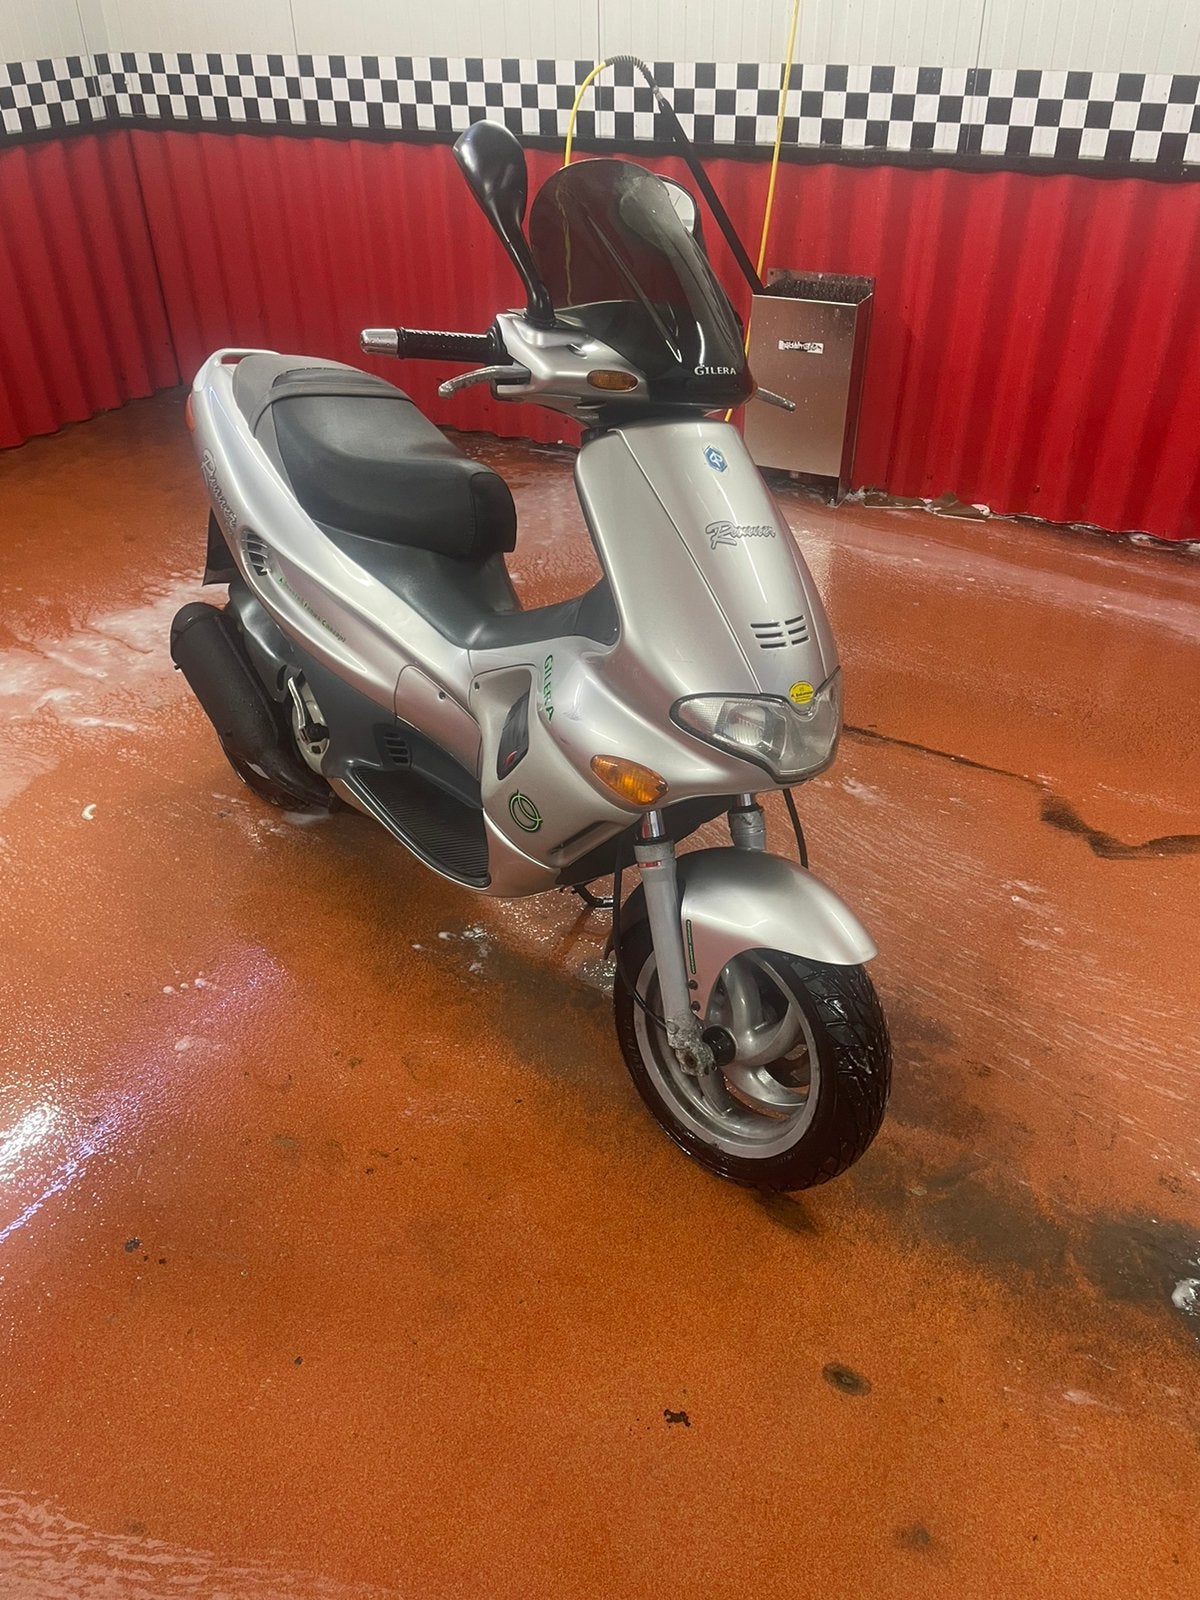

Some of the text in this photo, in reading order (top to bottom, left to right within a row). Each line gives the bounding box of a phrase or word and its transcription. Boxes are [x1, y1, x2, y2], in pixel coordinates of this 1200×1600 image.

[694, 366, 737, 376] GILERA
[201, 448, 237, 527] Runner
[705, 520, 776, 550] Runner
[543, 654, 555, 722] GILERA
